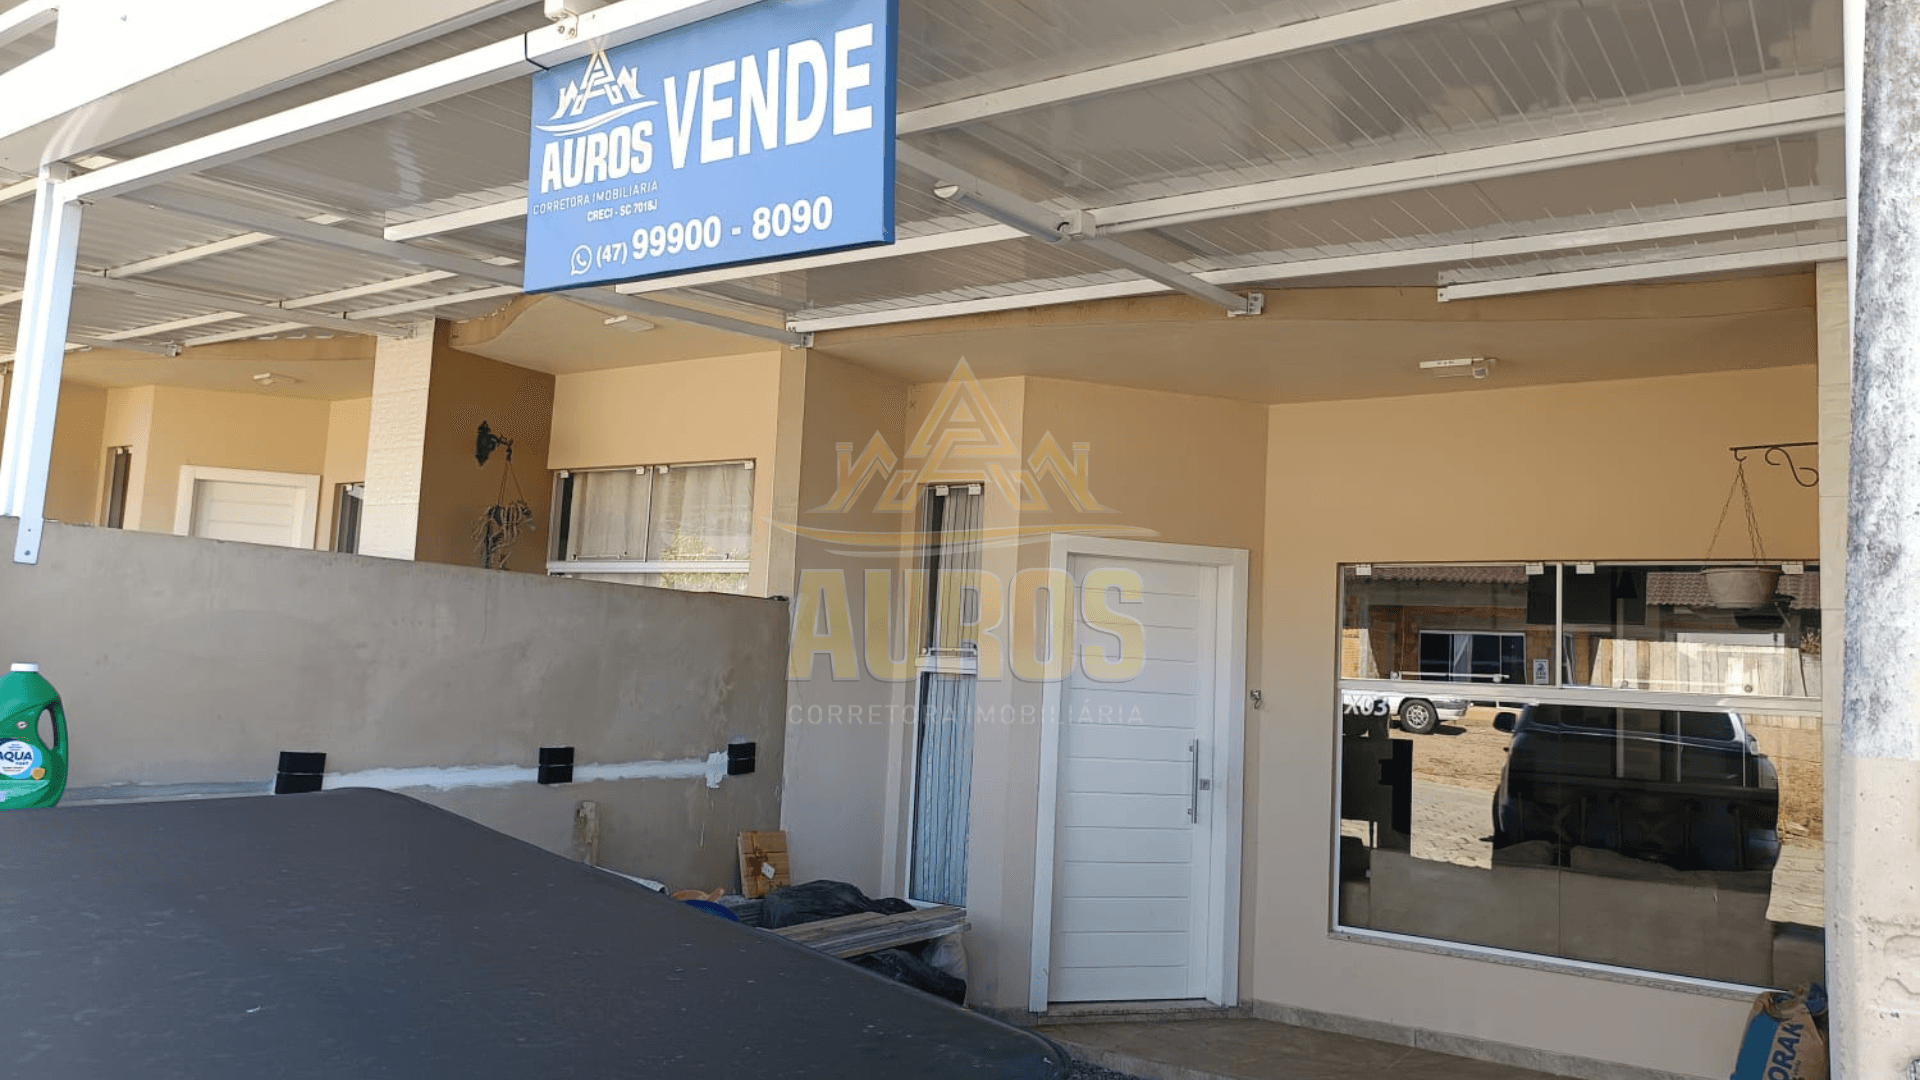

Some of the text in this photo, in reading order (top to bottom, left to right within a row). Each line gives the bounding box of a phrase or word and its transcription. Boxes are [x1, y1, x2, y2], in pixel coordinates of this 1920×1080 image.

[663, 22, 874, 171] VENDE
[540, 119, 654, 194] AUROS
[533, 180, 658, 215] CORRETORA IMOBILIÁRIA
[586, 208, 613, 223] CRECI
[620, 204, 632, 216] SC
[596, 242, 628, 269] (47)
[632, 215, 722, 260] 99900
[752, 195, 833, 241] 8090
